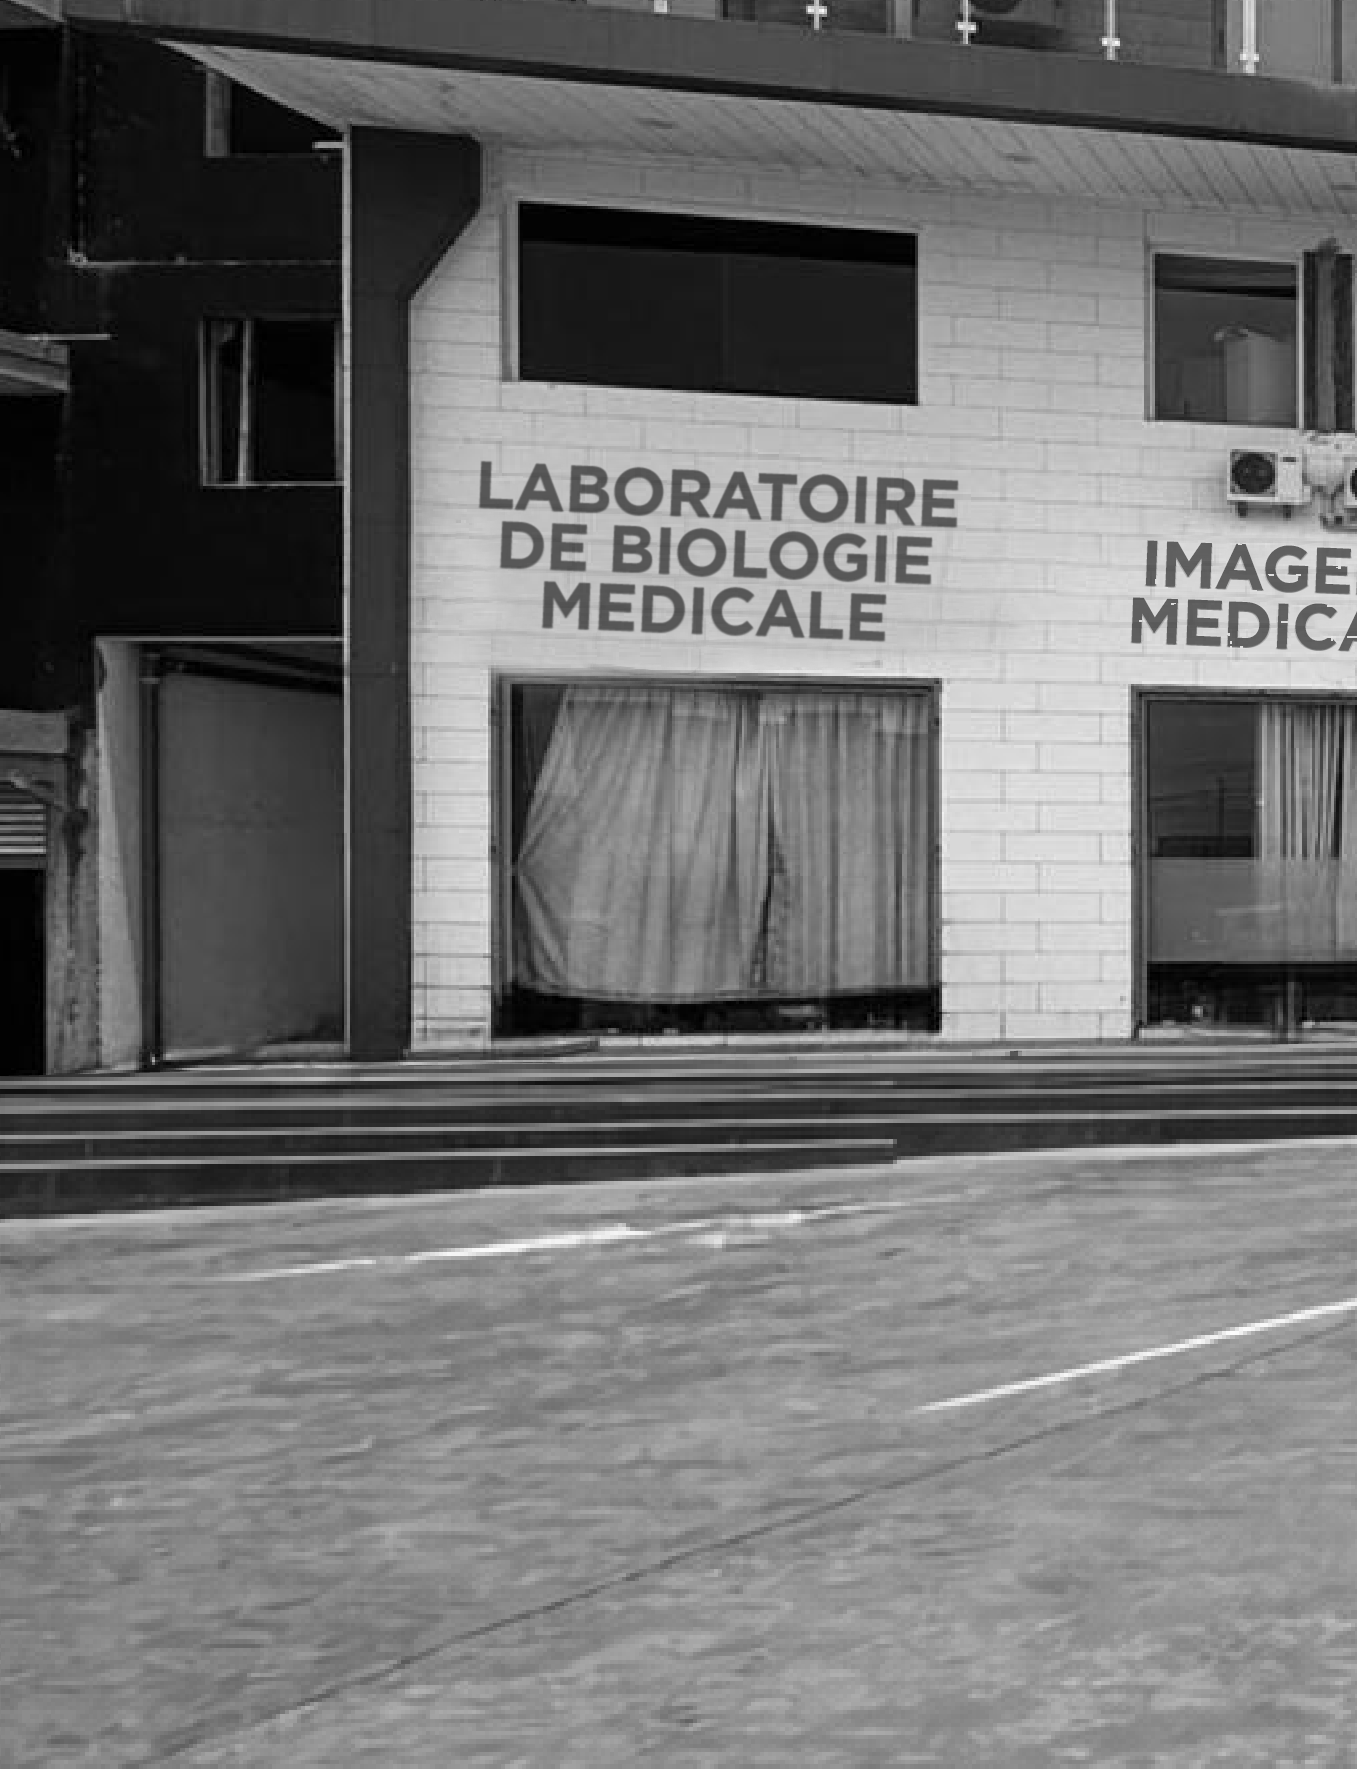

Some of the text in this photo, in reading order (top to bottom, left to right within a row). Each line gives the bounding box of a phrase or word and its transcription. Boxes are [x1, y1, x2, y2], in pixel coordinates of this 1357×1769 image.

[479, 461, 959, 528] LABORATOIRE
[500, 521, 933, 585] DE BIOLOGIE
[542, 581, 887, 642] MEDICALE
